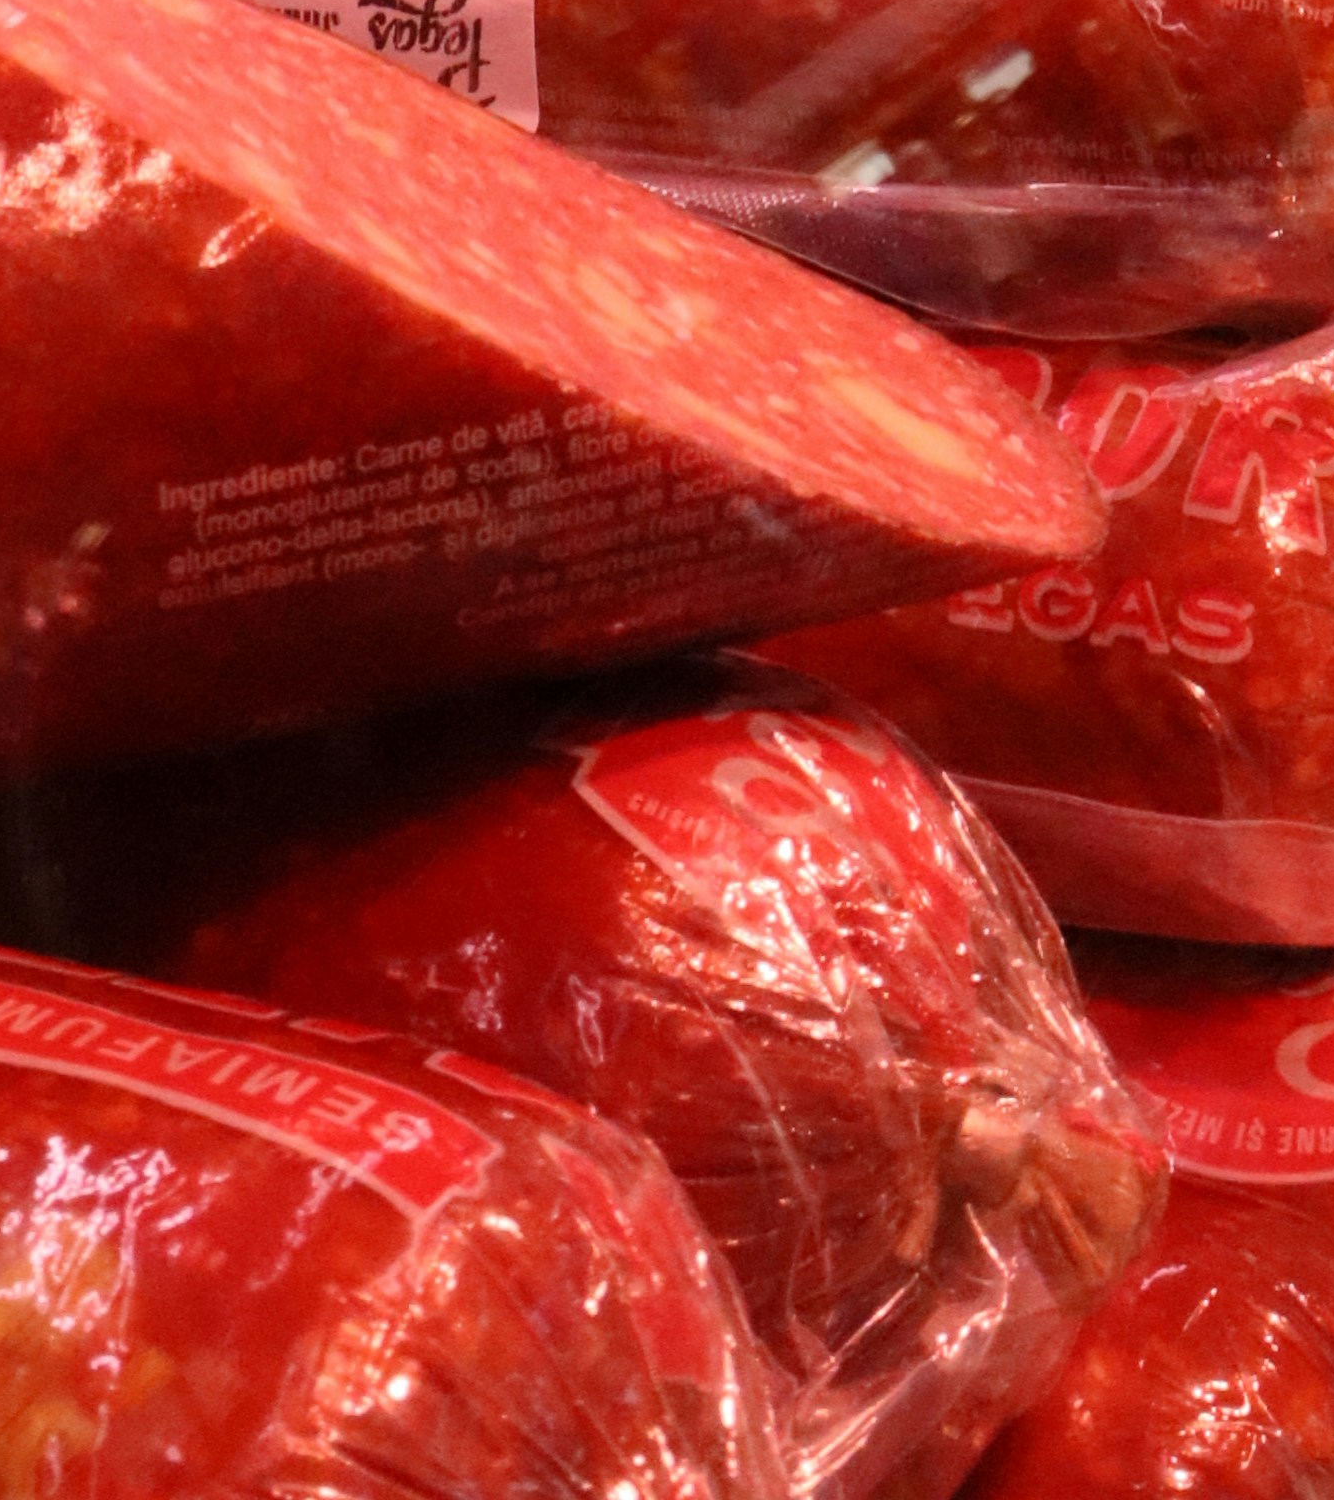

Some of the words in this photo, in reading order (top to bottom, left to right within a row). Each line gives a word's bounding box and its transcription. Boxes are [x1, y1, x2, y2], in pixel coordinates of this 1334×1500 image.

[158, 453, 347, 512] Ingrediente:
[355, 433, 445, 473] Carne
[451, 423, 488, 453] de
[421, 464, 457, 493] de
